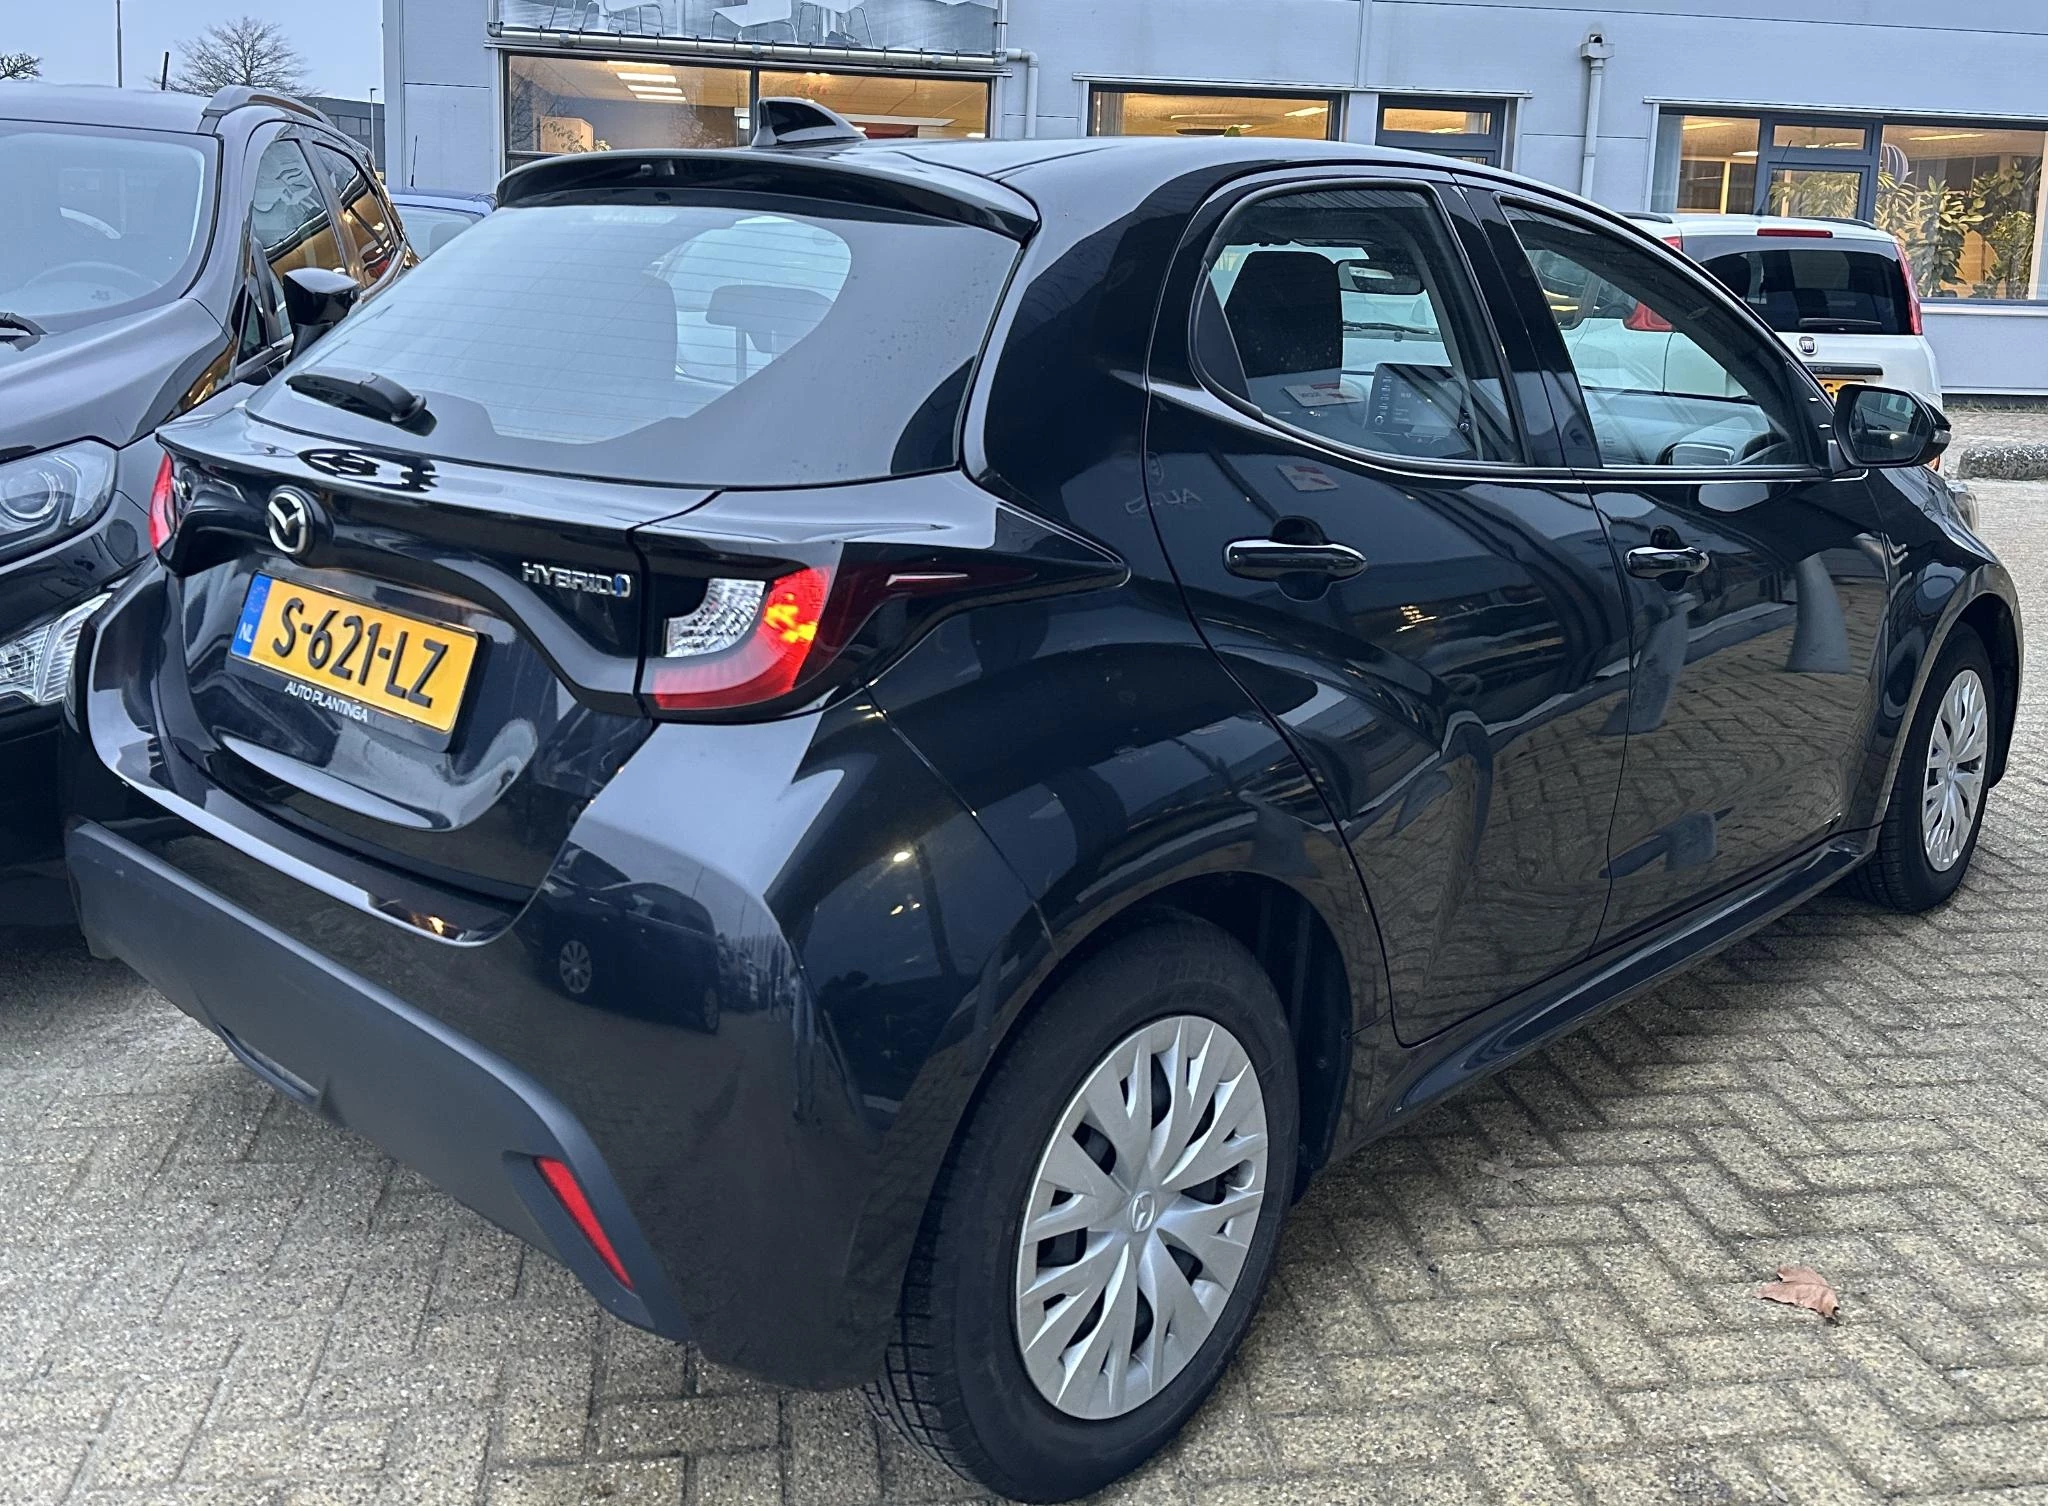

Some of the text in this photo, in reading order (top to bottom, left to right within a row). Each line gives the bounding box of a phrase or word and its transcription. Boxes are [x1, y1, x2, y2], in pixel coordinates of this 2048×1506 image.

[522, 562, 613, 595] HYBRID
[238, 622, 253, 642] NL
[272, 597, 449, 709] S-621-LZ
[284, 681, 368, 722] AUTO PLANTINGA
